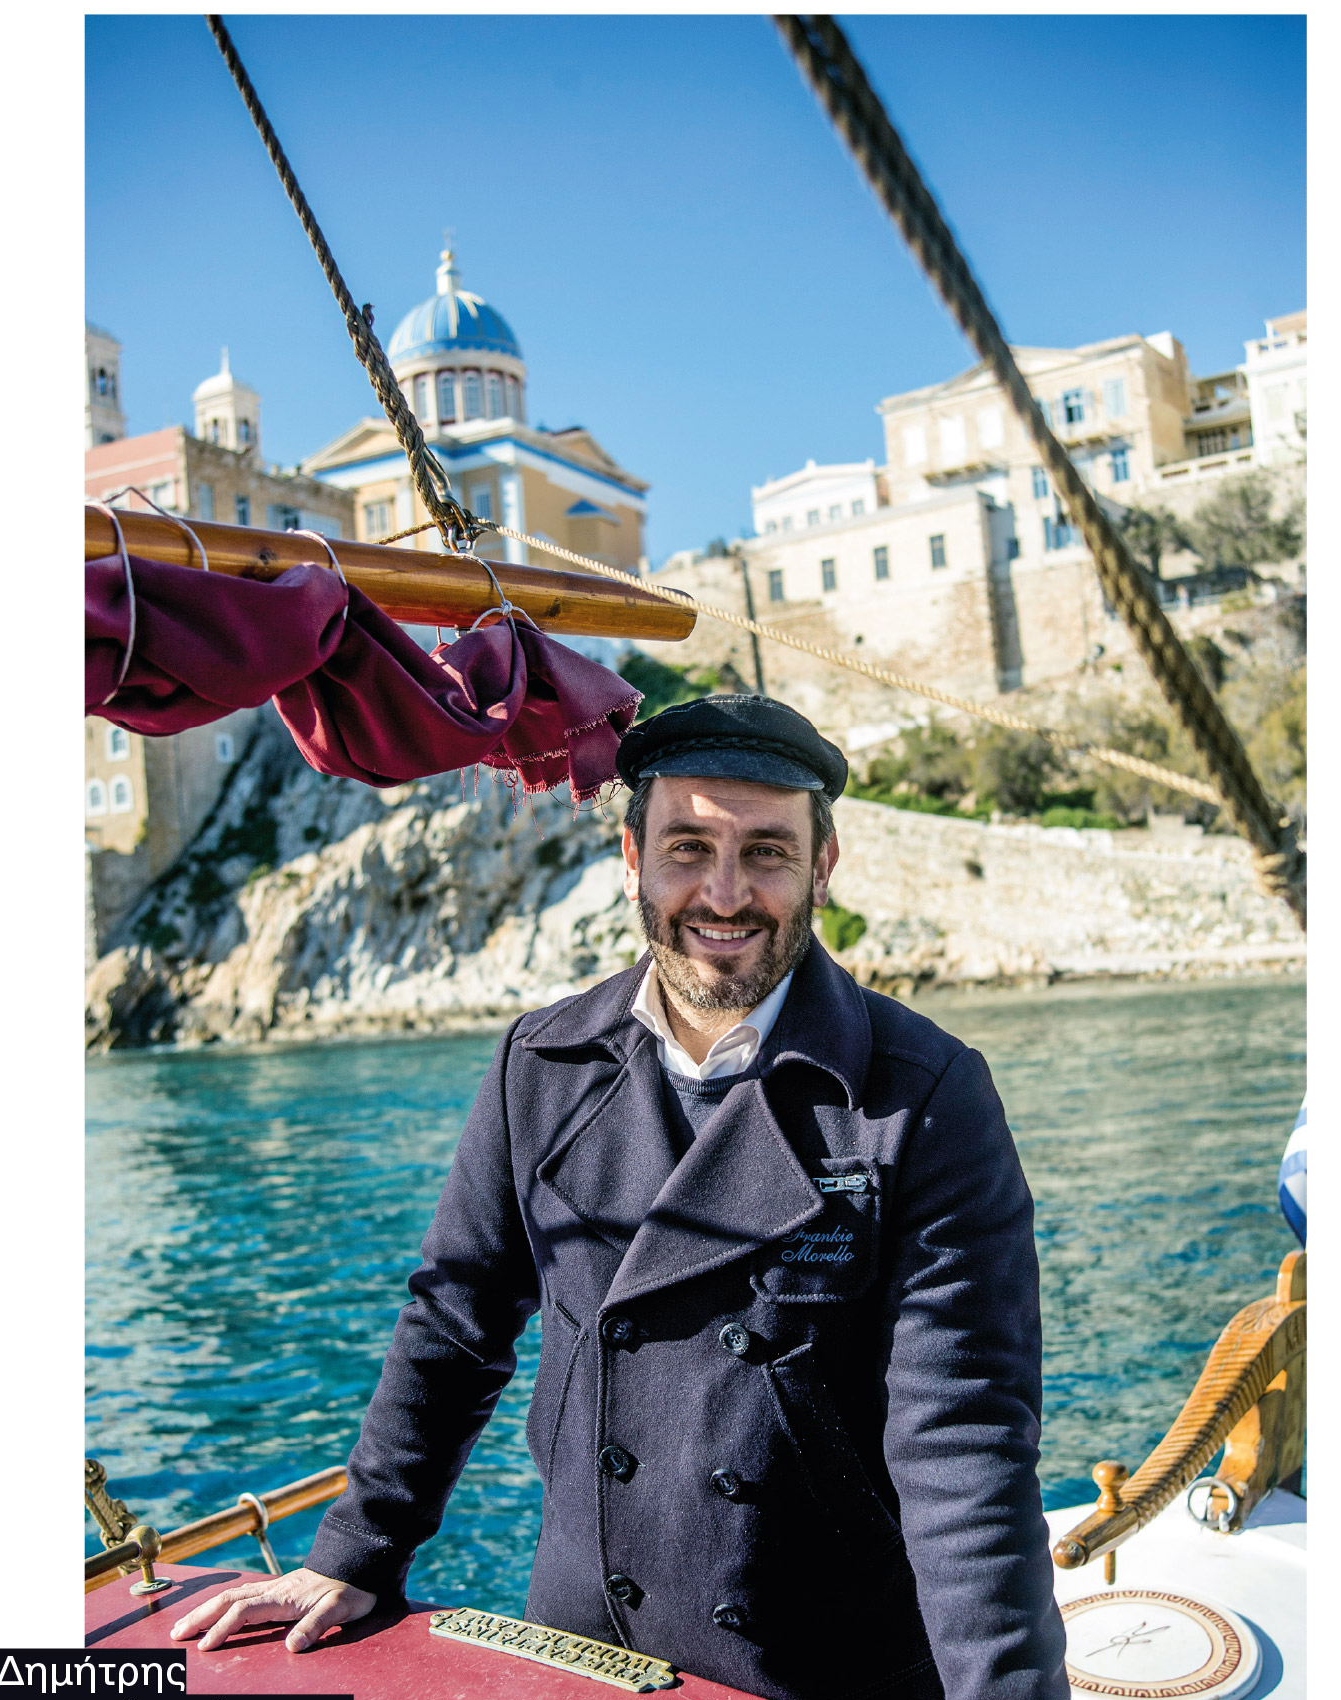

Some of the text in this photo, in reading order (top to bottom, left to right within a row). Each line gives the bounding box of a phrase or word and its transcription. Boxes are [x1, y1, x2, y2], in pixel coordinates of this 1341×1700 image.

[781, 1224, 854, 1243] Frankie
[781, 1242, 855, 1263] Morello
[465, 1611, 531, 1638] LAW
[571, 1641, 655, 1674] WORD
[585, 1656, 642, 1685] THE
